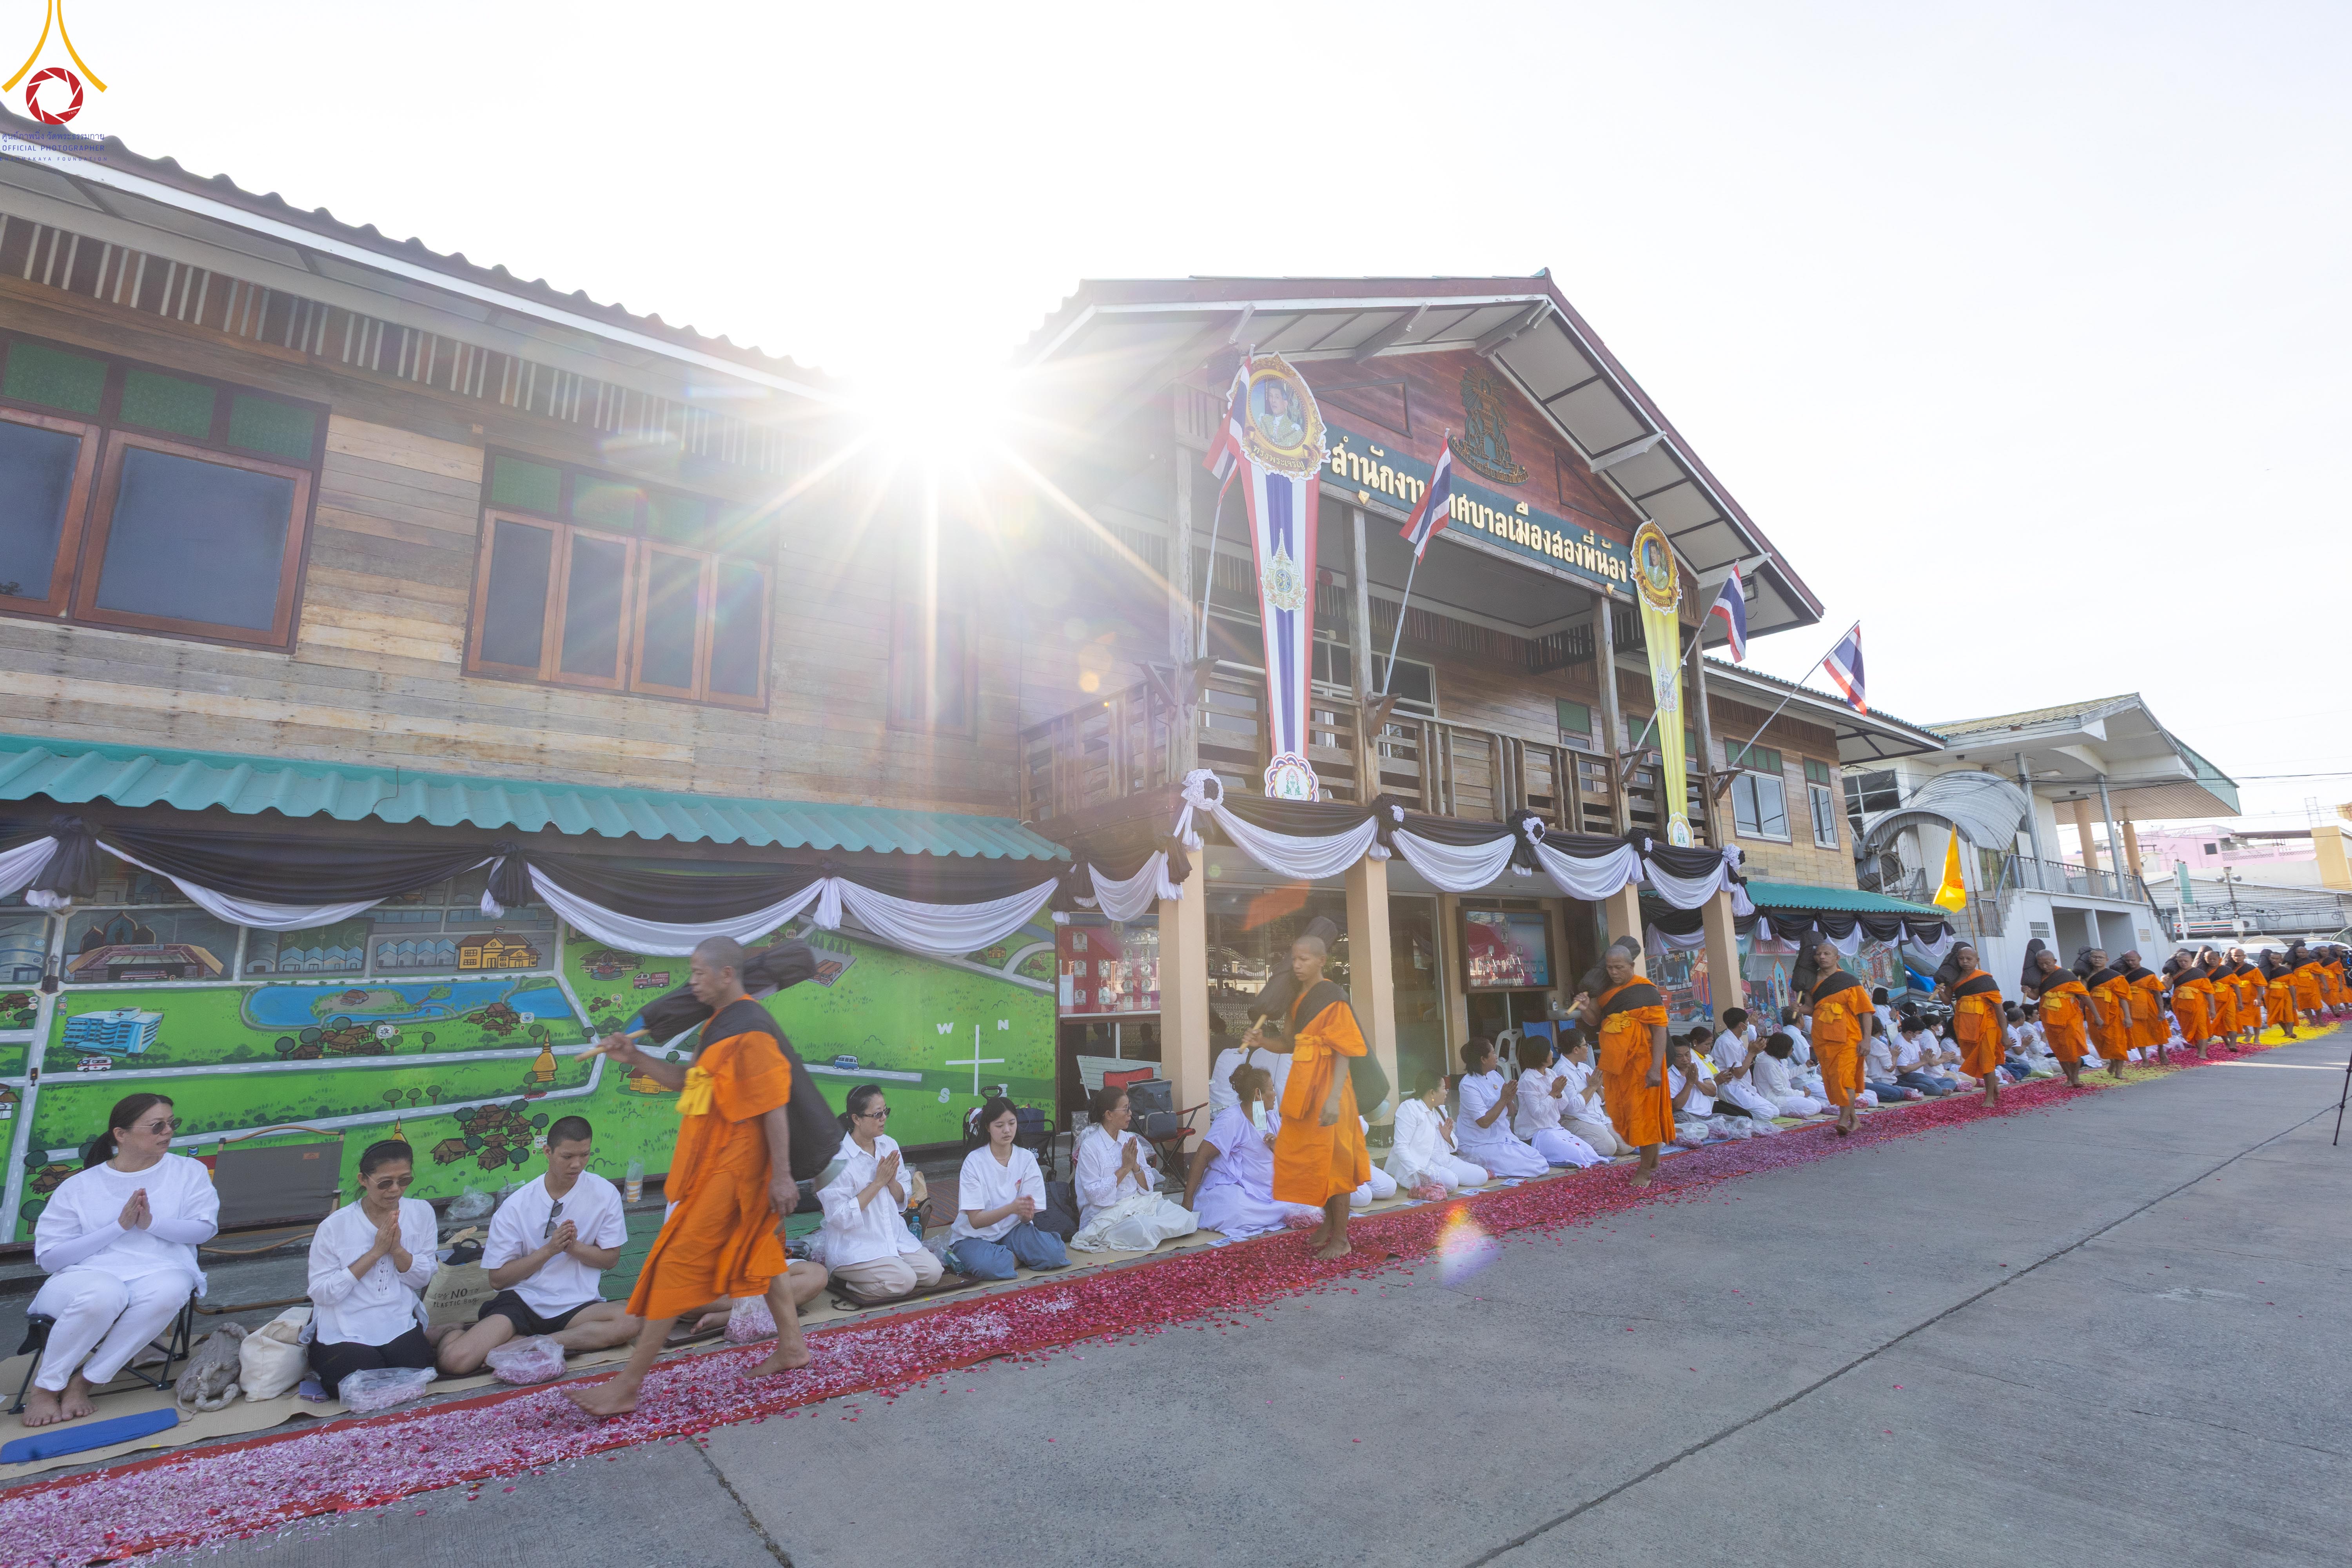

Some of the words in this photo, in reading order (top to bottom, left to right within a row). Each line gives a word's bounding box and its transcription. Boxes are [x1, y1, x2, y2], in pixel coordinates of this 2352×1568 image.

[1253, 445, 1306, 470] ทรงพระเจริญ
[1646, 590, 1671, 606] ทรงพระเจริญ
[936, 1022, 954, 1034] W
[998, 1020, 1009, 1030] N
[938, 1088, 950, 1103] S
[451, 1288, 468, 1299] NO
